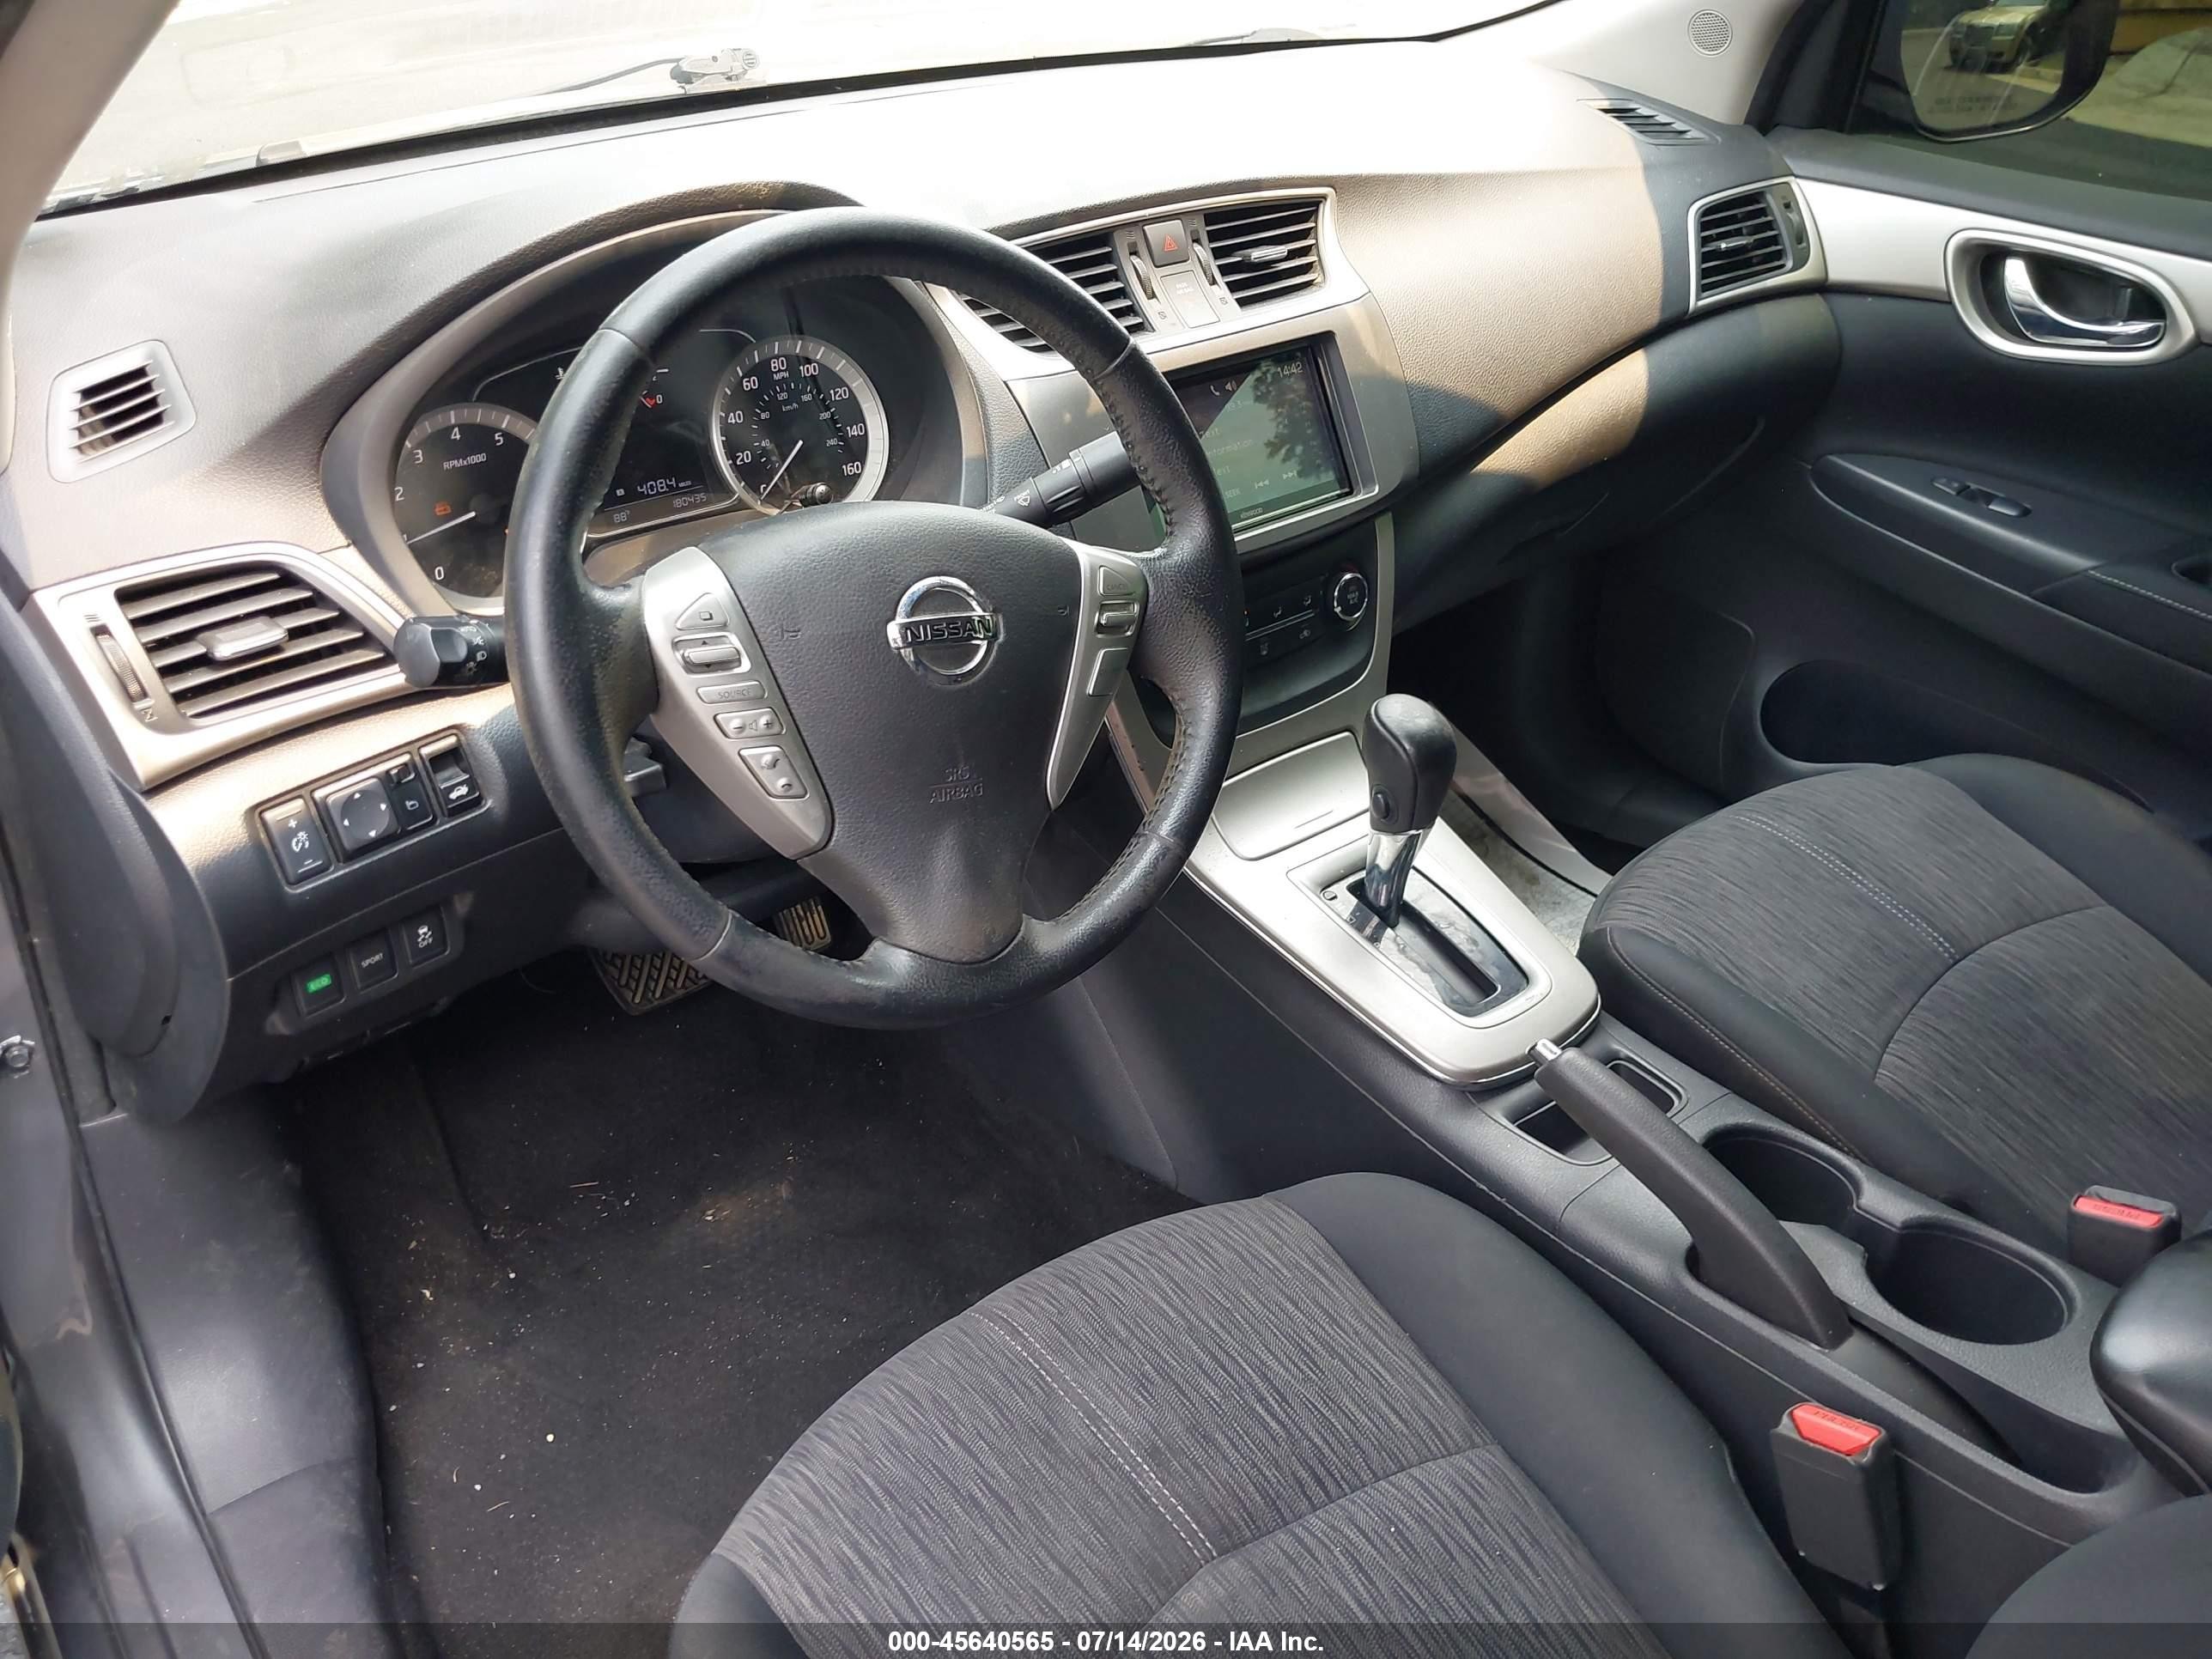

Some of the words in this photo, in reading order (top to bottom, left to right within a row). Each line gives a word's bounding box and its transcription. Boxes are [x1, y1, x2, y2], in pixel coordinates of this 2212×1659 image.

[770, 356, 787, 372] 80
[799, 362, 819, 377] 100
[1277, 362, 1304, 378] 14:42
[773, 371, 789, 380] MPH
[742, 376, 758, 391] 60
[776, 392, 788, 400] 120
[801, 393, 812, 402] 160
[830, 386, 849, 401] 120
[782, 403, 799, 412] km/h
[727, 410, 744, 424] 40
[451, 427, 461, 441] 4
[847, 423, 866, 438] 140
[495, 432, 504, 446] 5
[413, 449, 423, 464] 3
[443, 453, 487, 470] RPMx1000
[736, 451, 751, 465] 20
[842, 461, 862, 477] 160
[394, 486, 404, 501] 2
[434, 566, 445, 581] 0
[904, 617, 994, 642] NISSAN
[417, 937, 434, 948] OFF
[361, 952, 384, 968] SPORT
